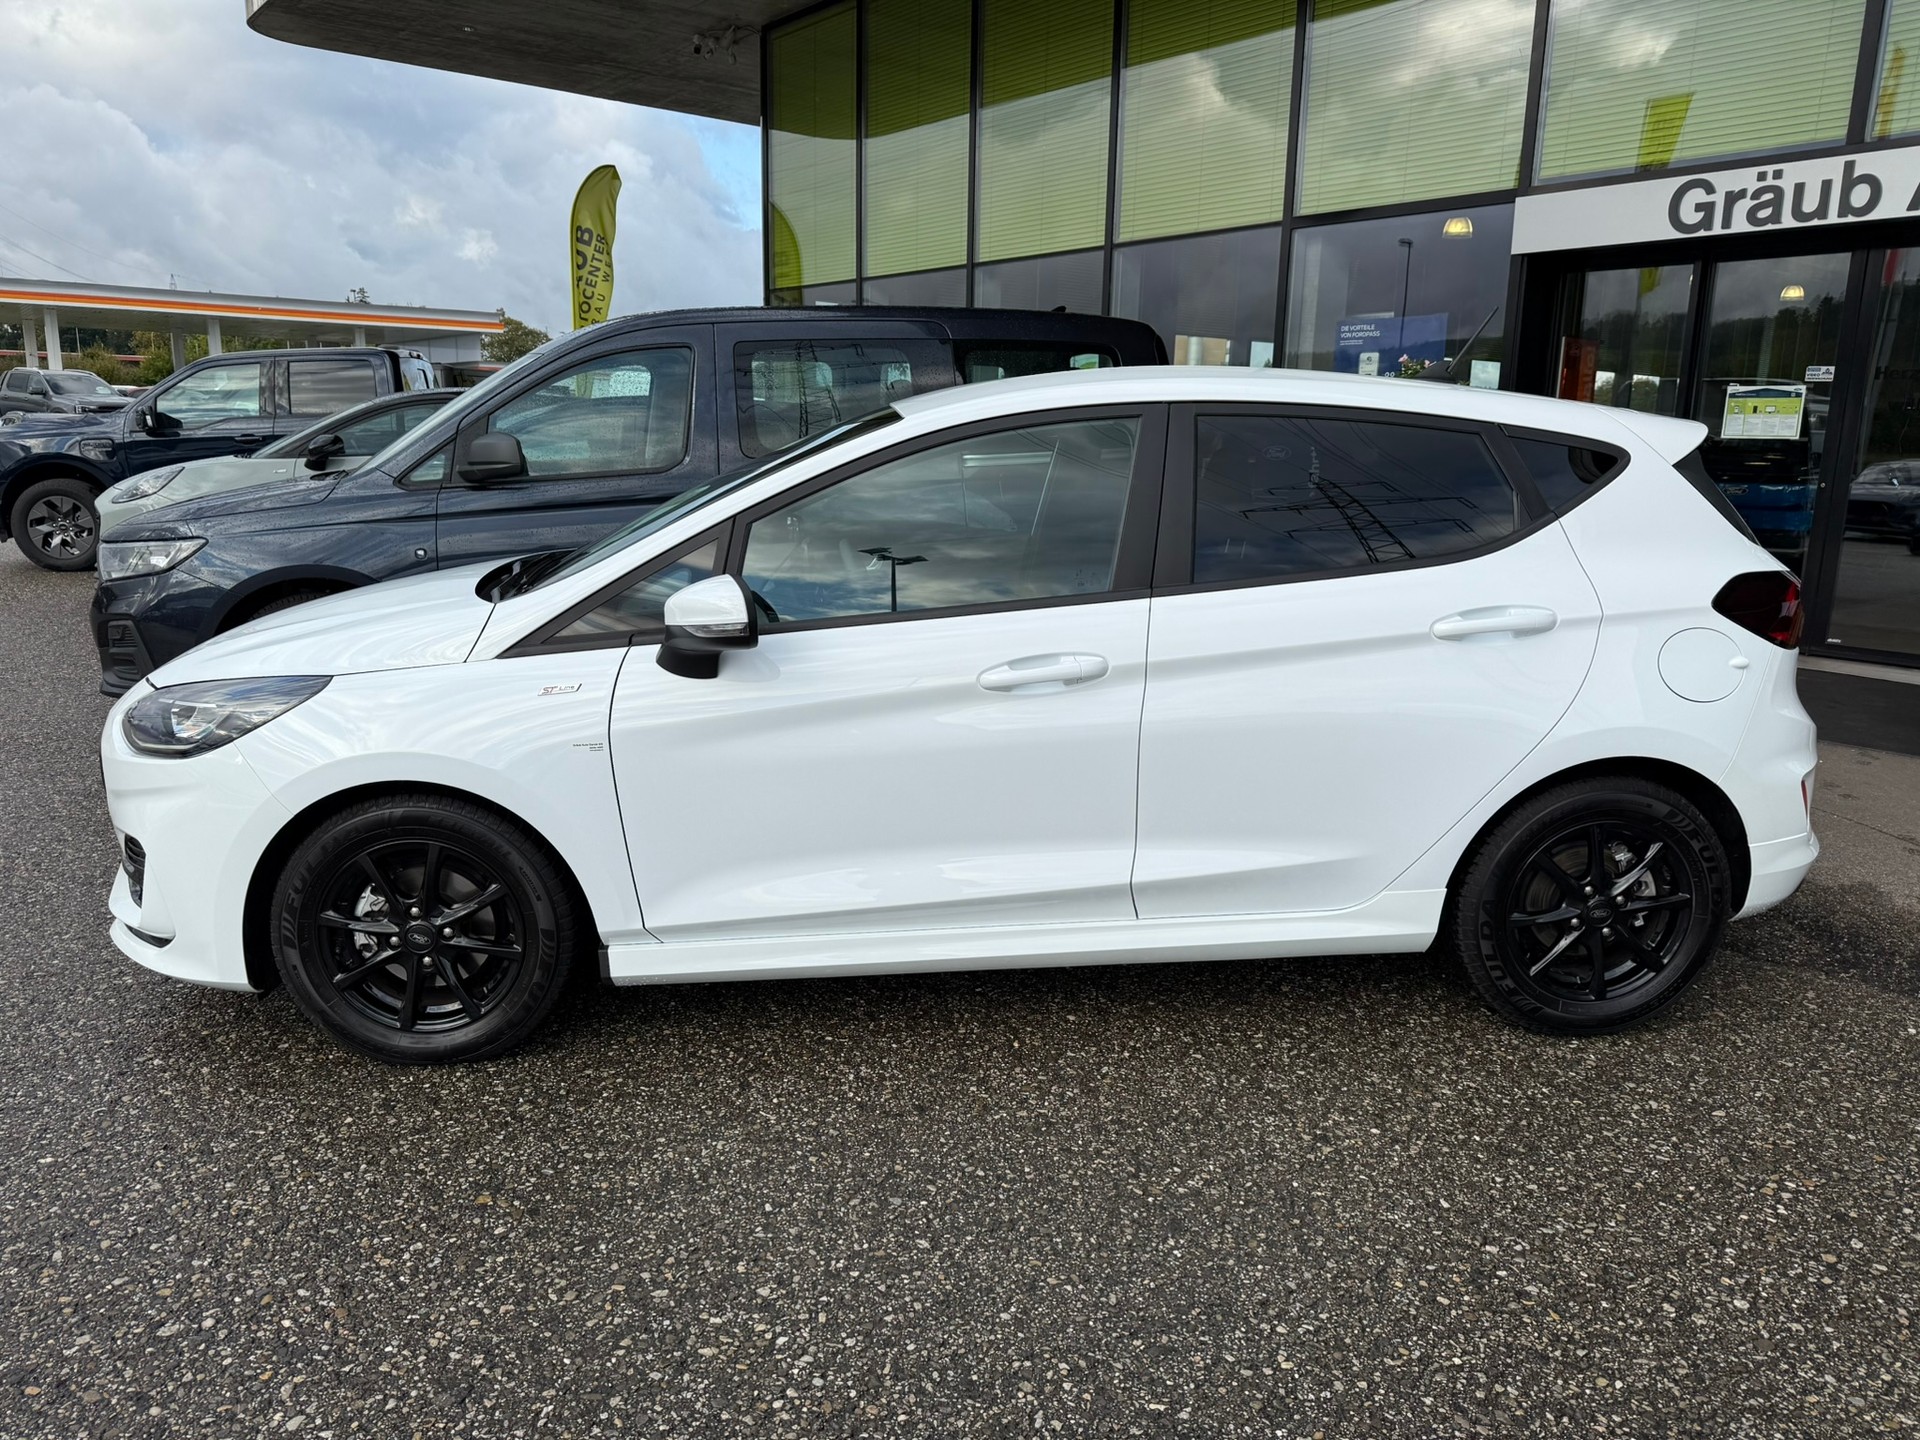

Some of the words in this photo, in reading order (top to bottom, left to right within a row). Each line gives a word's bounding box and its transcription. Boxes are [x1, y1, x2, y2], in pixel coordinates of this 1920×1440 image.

[1668, 159, 1883, 234] Gräub
[1350, 323, 1376, 331] VORTEILE
[542, 685, 558, 695] ST
